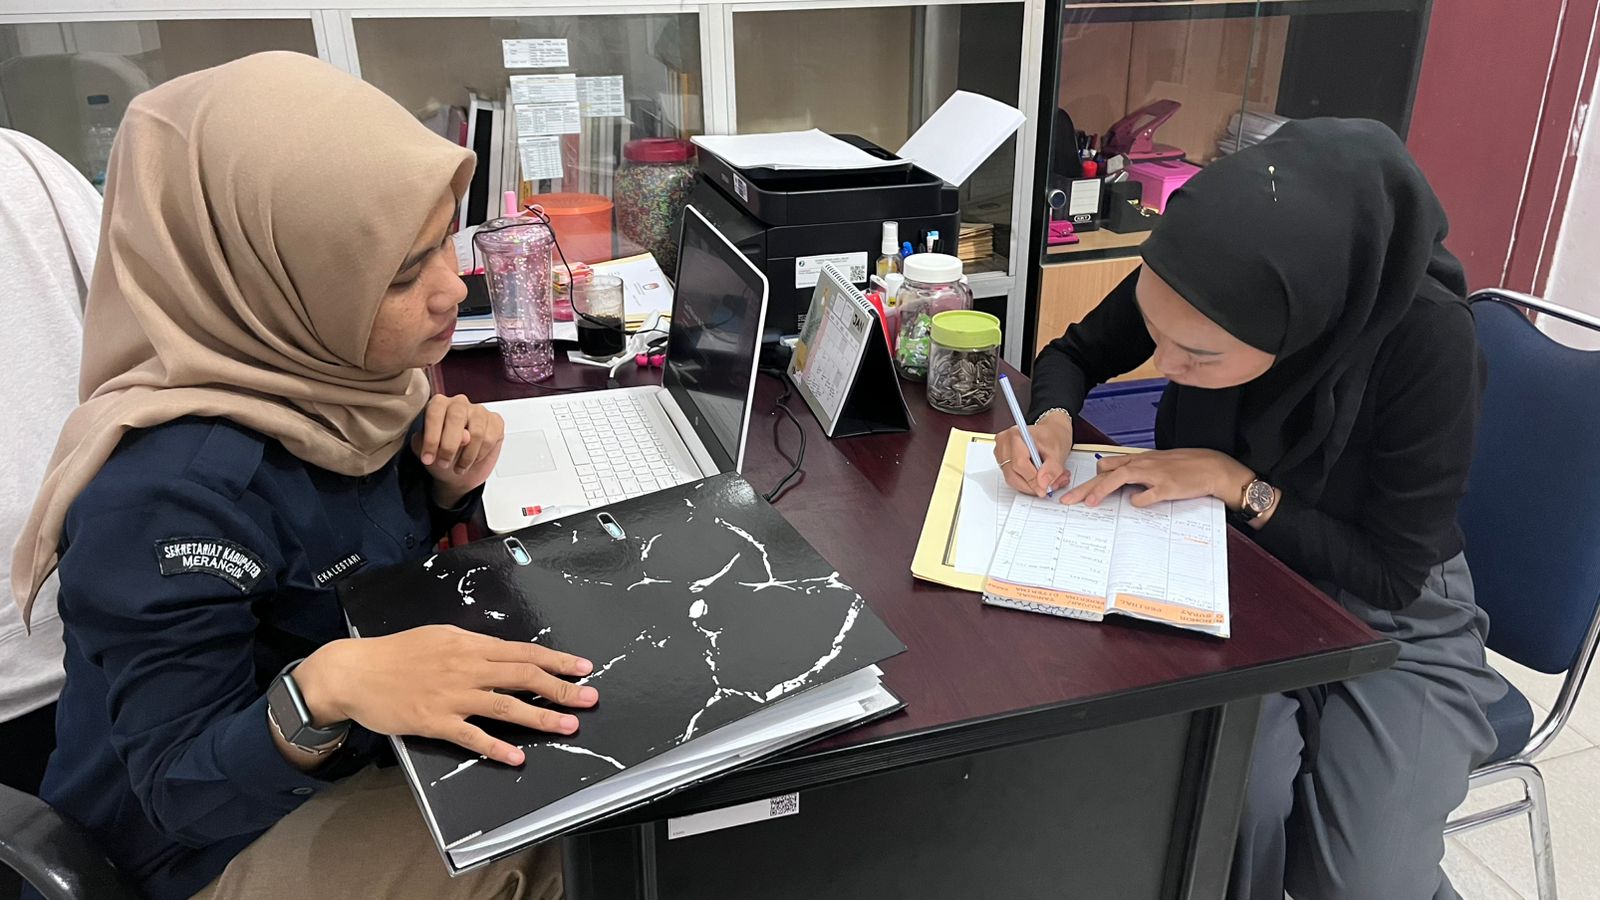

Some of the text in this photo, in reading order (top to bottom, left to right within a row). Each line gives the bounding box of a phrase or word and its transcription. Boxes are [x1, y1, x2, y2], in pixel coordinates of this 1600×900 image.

[852, 313, 865, 334] JAN
[164, 542, 223, 558] SEKRETARIAT
[182, 555, 244, 579] MERANGIN
[317, 553, 361, 583] EKA LESTARI
[1179, 615, 1213, 623] NOMOR
[1180, 609, 1212, 618] SURAT
